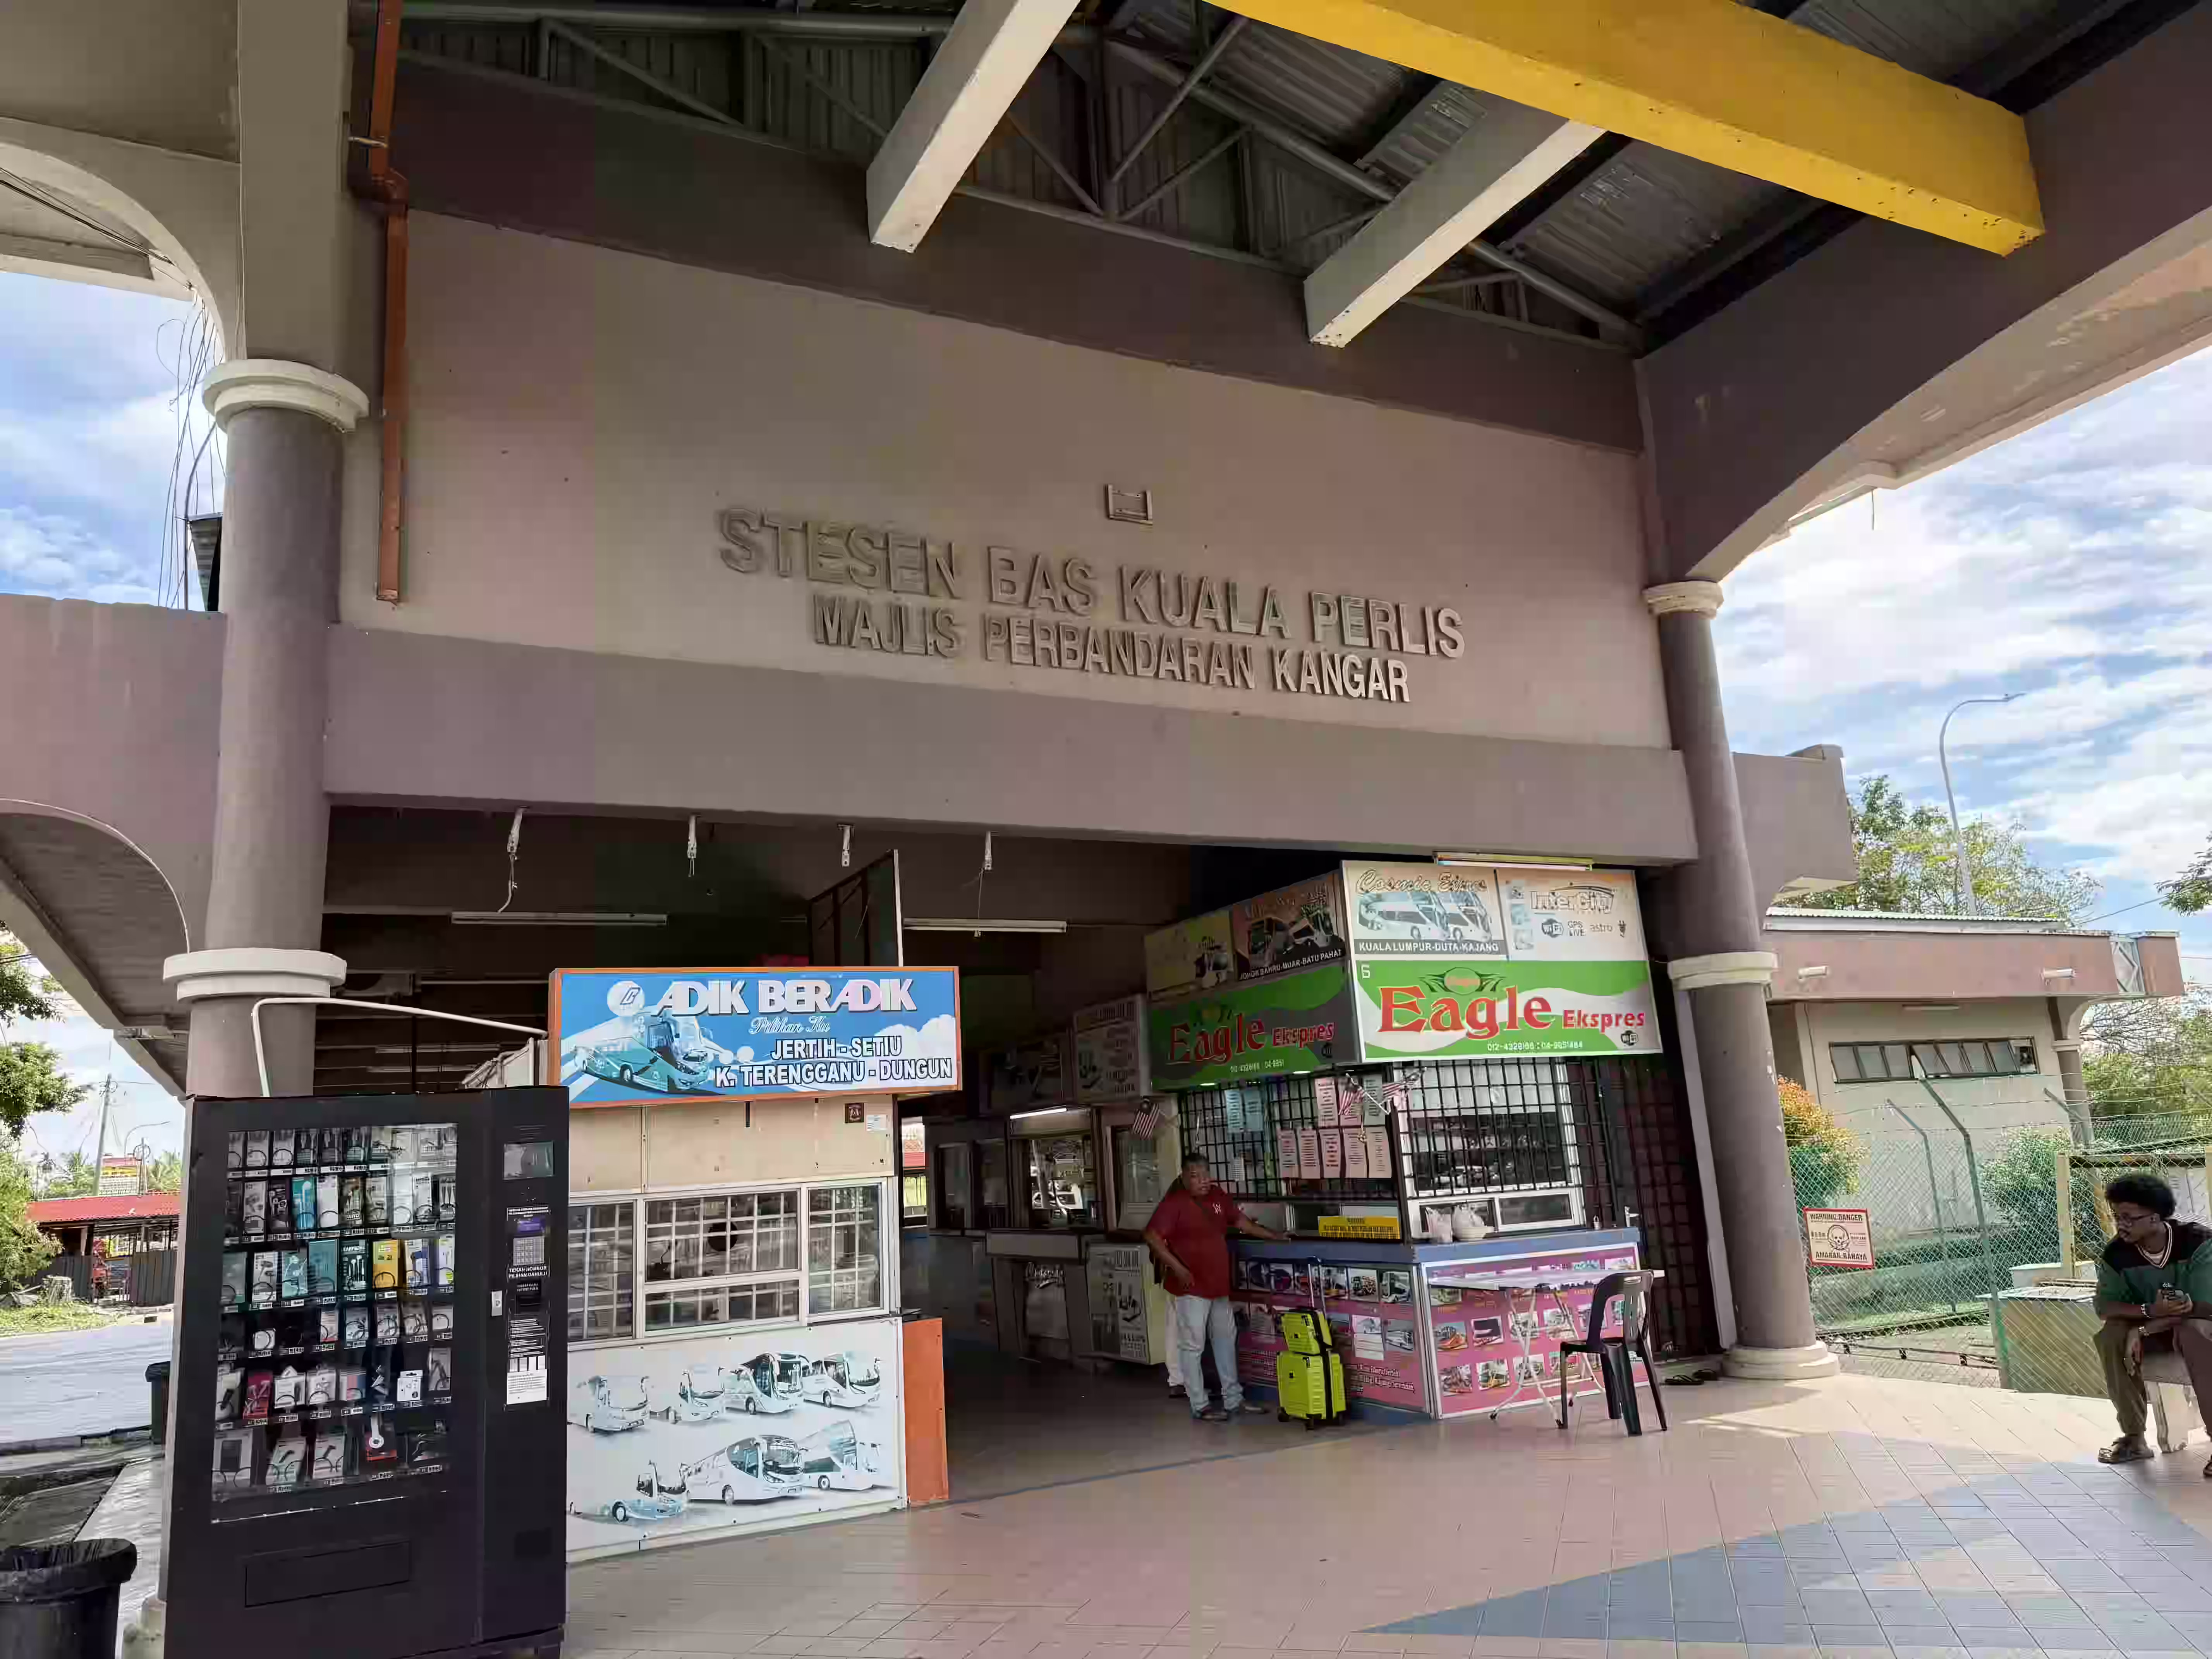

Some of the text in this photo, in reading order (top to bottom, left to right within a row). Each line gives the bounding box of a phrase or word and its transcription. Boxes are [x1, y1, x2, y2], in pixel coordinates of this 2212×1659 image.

[719, 508, 1465, 658] STESEN BAS KUALA PERLIS
[813, 594, 1410, 702] MAJLIS PERBANDARAN KANGAR
[1359, 942, 1393, 952] KUALA
[651, 979, 750, 1017] ADIK
[759, 978, 918, 1015] BERADIK
[1376, 985, 1646, 1041] Eagle Ekspres
[1166, 1012, 1267, 1065] Eagle
[715, 1065, 736, 1087] K.
[740, 1060, 866, 1087] TERENGGANU
[879, 1058, 952, 1081] DUNGUN
